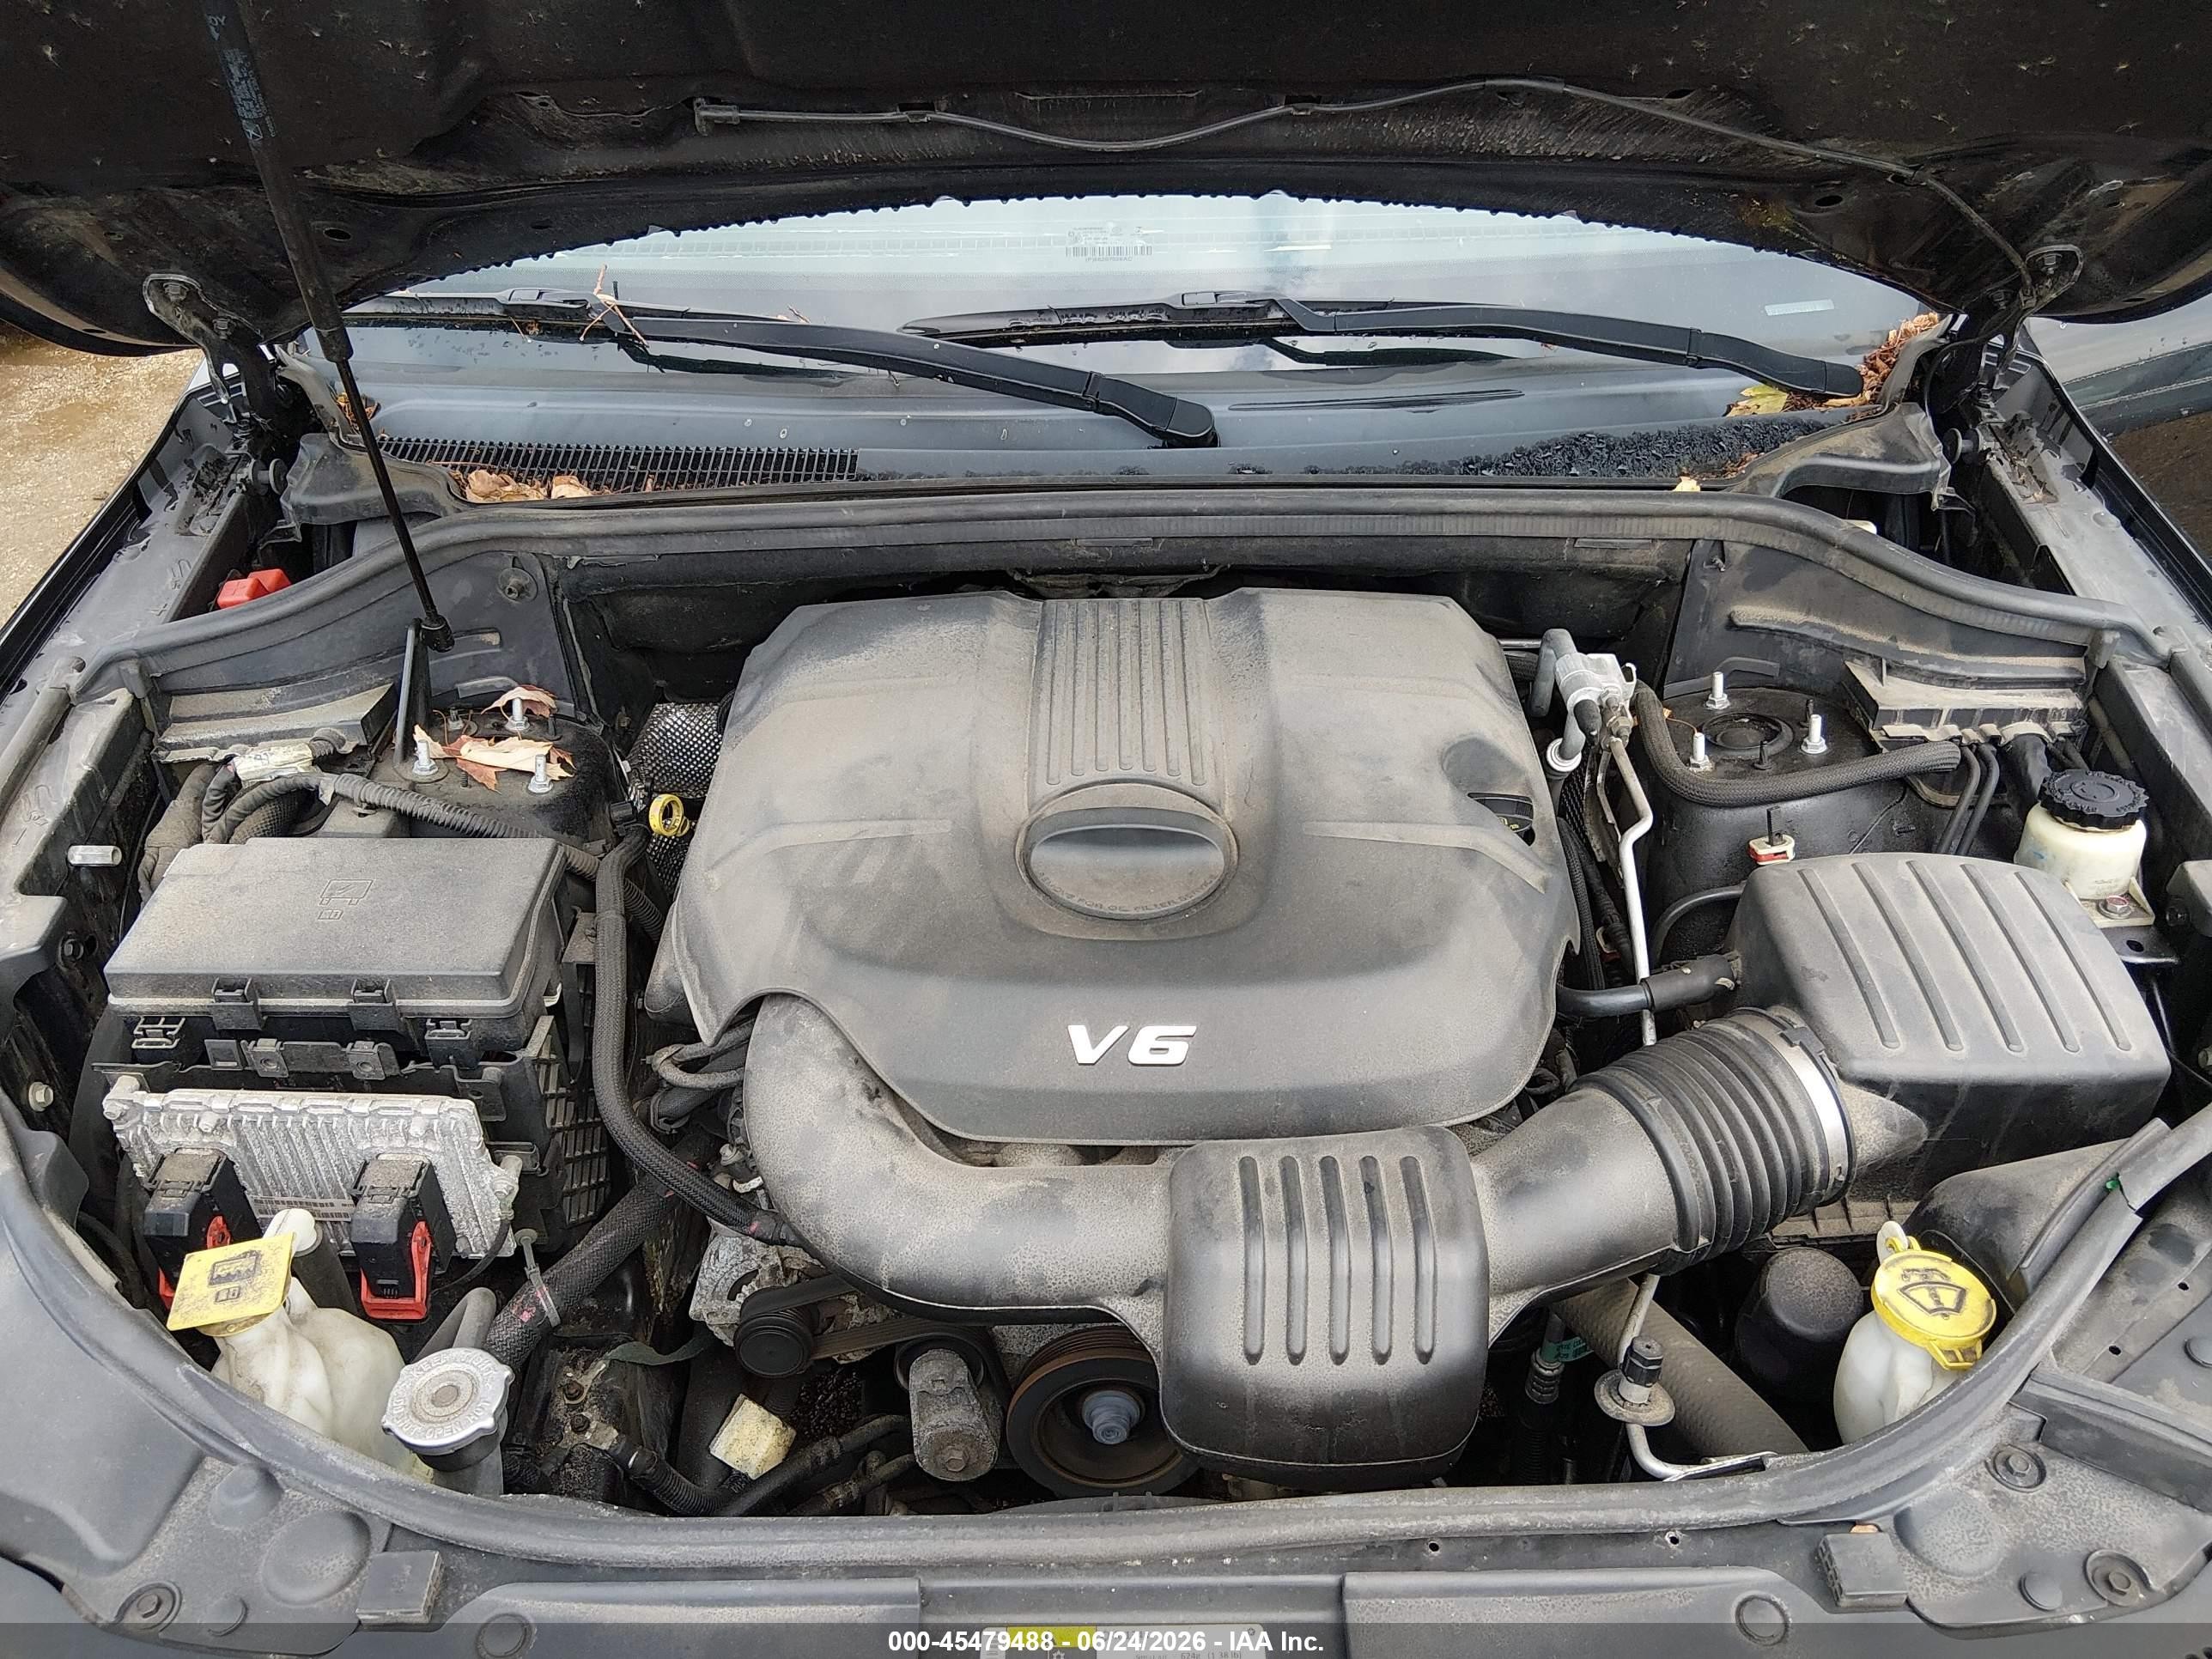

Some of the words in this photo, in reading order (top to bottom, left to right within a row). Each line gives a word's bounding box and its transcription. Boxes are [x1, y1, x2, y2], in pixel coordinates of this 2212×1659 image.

[1067, 1024, 1197, 1066] V6
[413, 1355, 447, 1377] KEEP
[459, 1350, 497, 1377] TIGHT
[425, 1421, 464, 1438] OPEN
[467, 1400, 492, 1424] HOT
